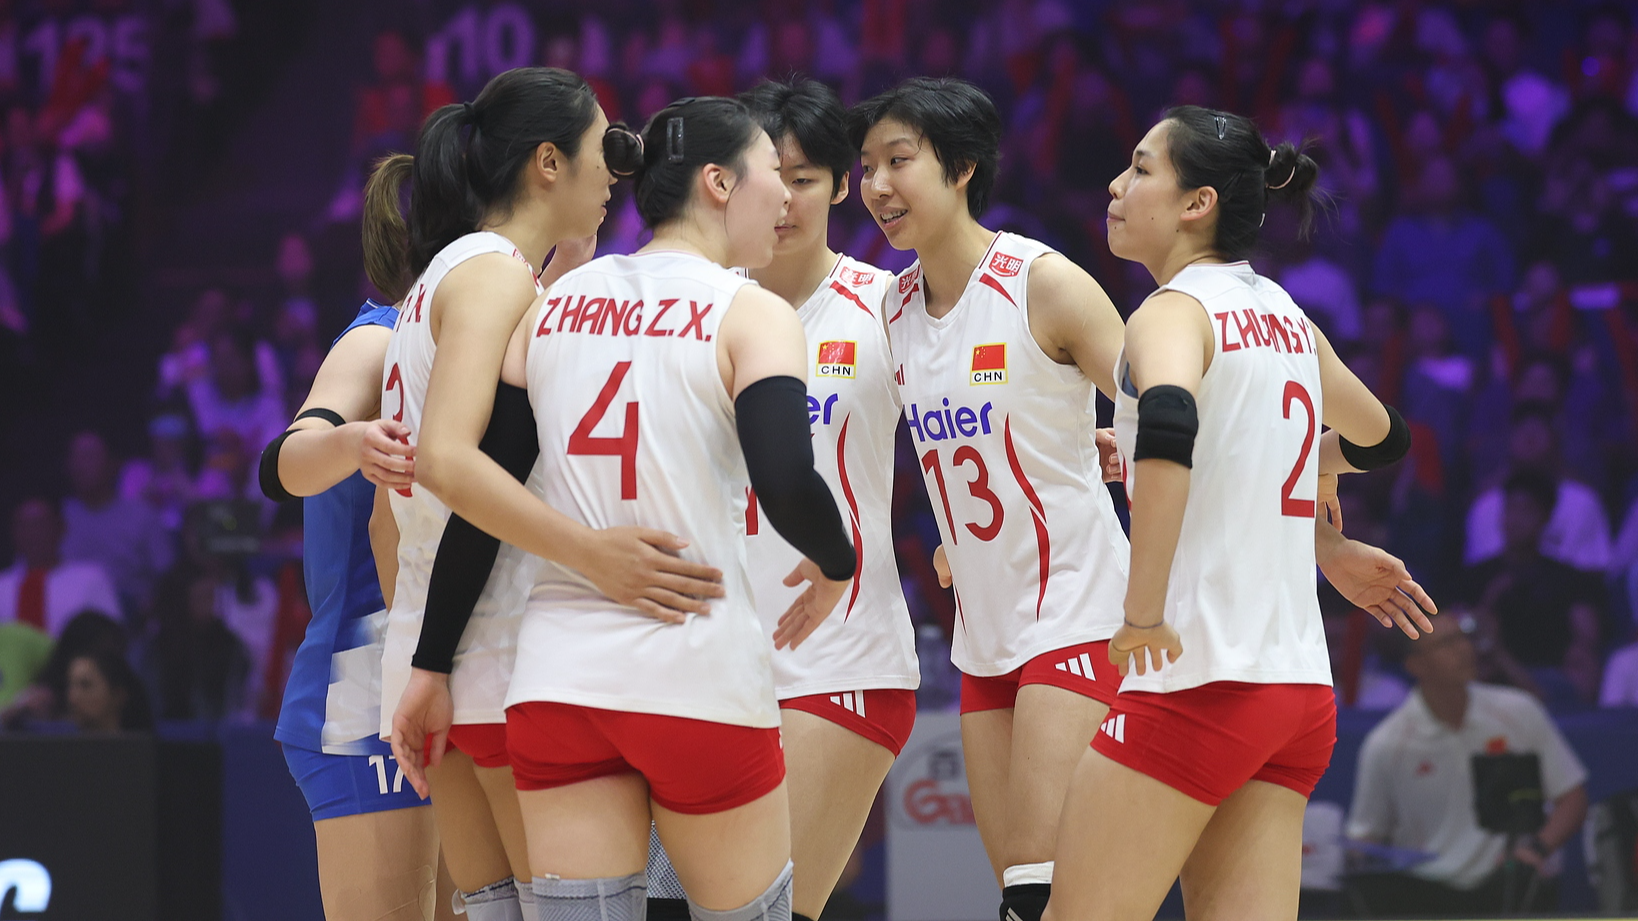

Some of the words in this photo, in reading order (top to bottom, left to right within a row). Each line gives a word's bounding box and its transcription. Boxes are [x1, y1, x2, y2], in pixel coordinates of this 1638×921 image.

[992, 253, 1021, 271] 光明
[536, 294, 644, 338] ZHANG
[644, 298, 714, 342] Z.X.
[821, 364, 851, 376] CHN
[974, 371, 1003, 382] CHN
[566, 360, 640, 501] 4
[904, 397, 993, 442] Haier
[1281, 380, 1316, 518] 2
[922, 445, 1005, 545] 13
[368, 754, 405, 795] 17
